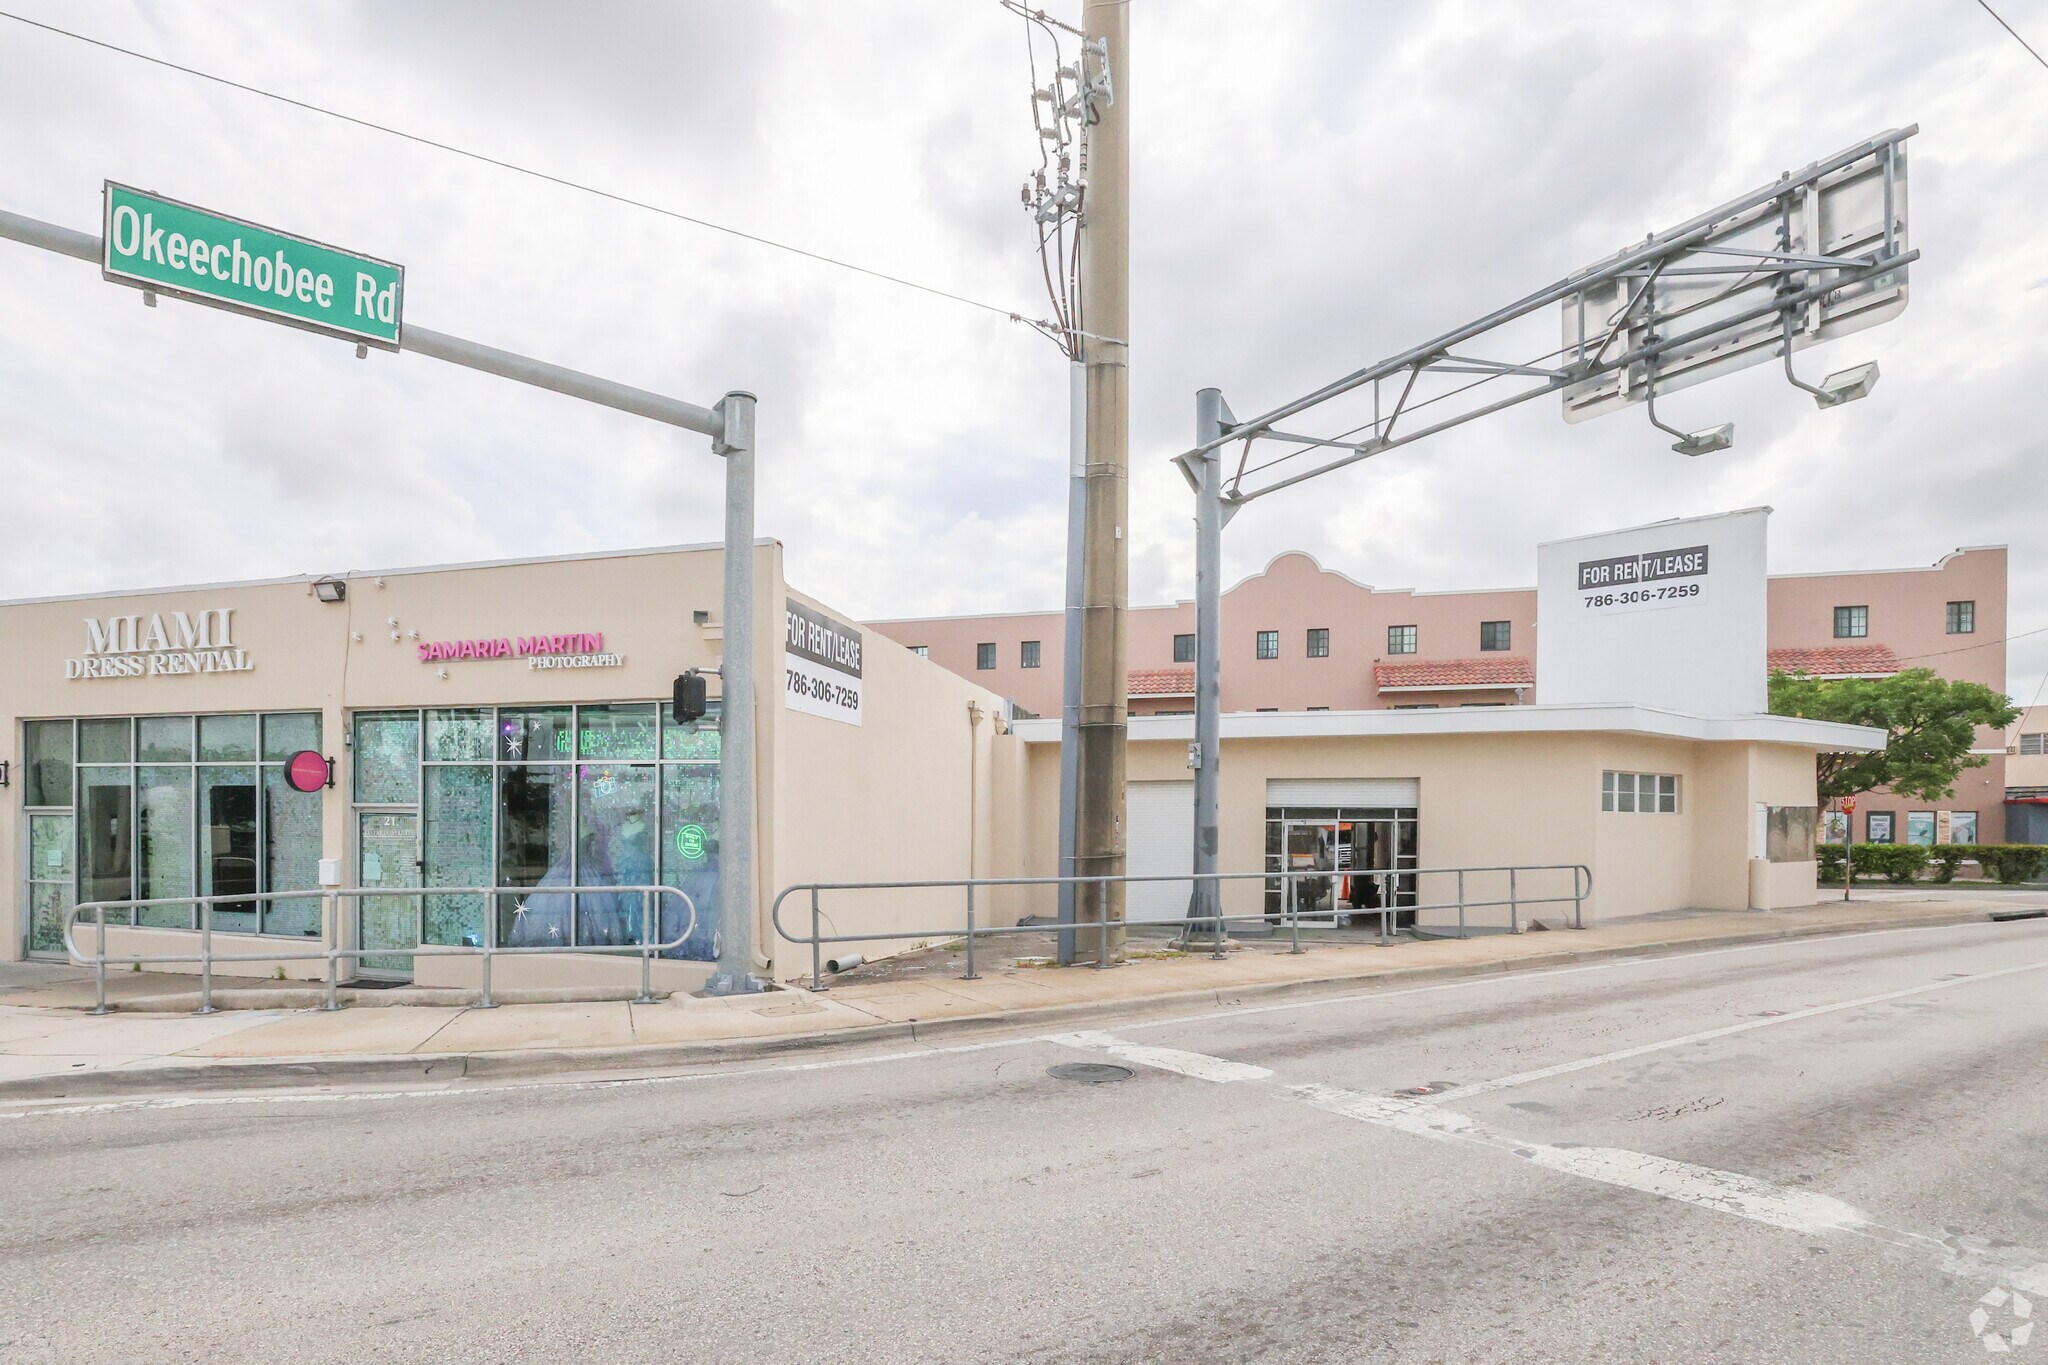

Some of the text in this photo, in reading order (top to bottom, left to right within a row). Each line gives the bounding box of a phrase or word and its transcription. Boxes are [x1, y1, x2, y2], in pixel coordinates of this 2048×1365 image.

[112, 205, 397, 325] Okeechobee Rd
[1582, 553, 1703, 585] FOR RENT/LEASE
[1584, 584, 1700, 608] 786-306-7259
[82, 607, 236, 656] MIAMI
[416, 631, 604, 661] SAMARIA MARTIN
[786, 611, 860, 670] FOR RENT/LEASE
[64, 649, 254, 680] DRESS RENTAL
[528, 653, 625, 670] PHOTOGRAPHY
[786, 669, 859, 710] 786-306-7259
[1841, 796, 1856, 805] STOP
